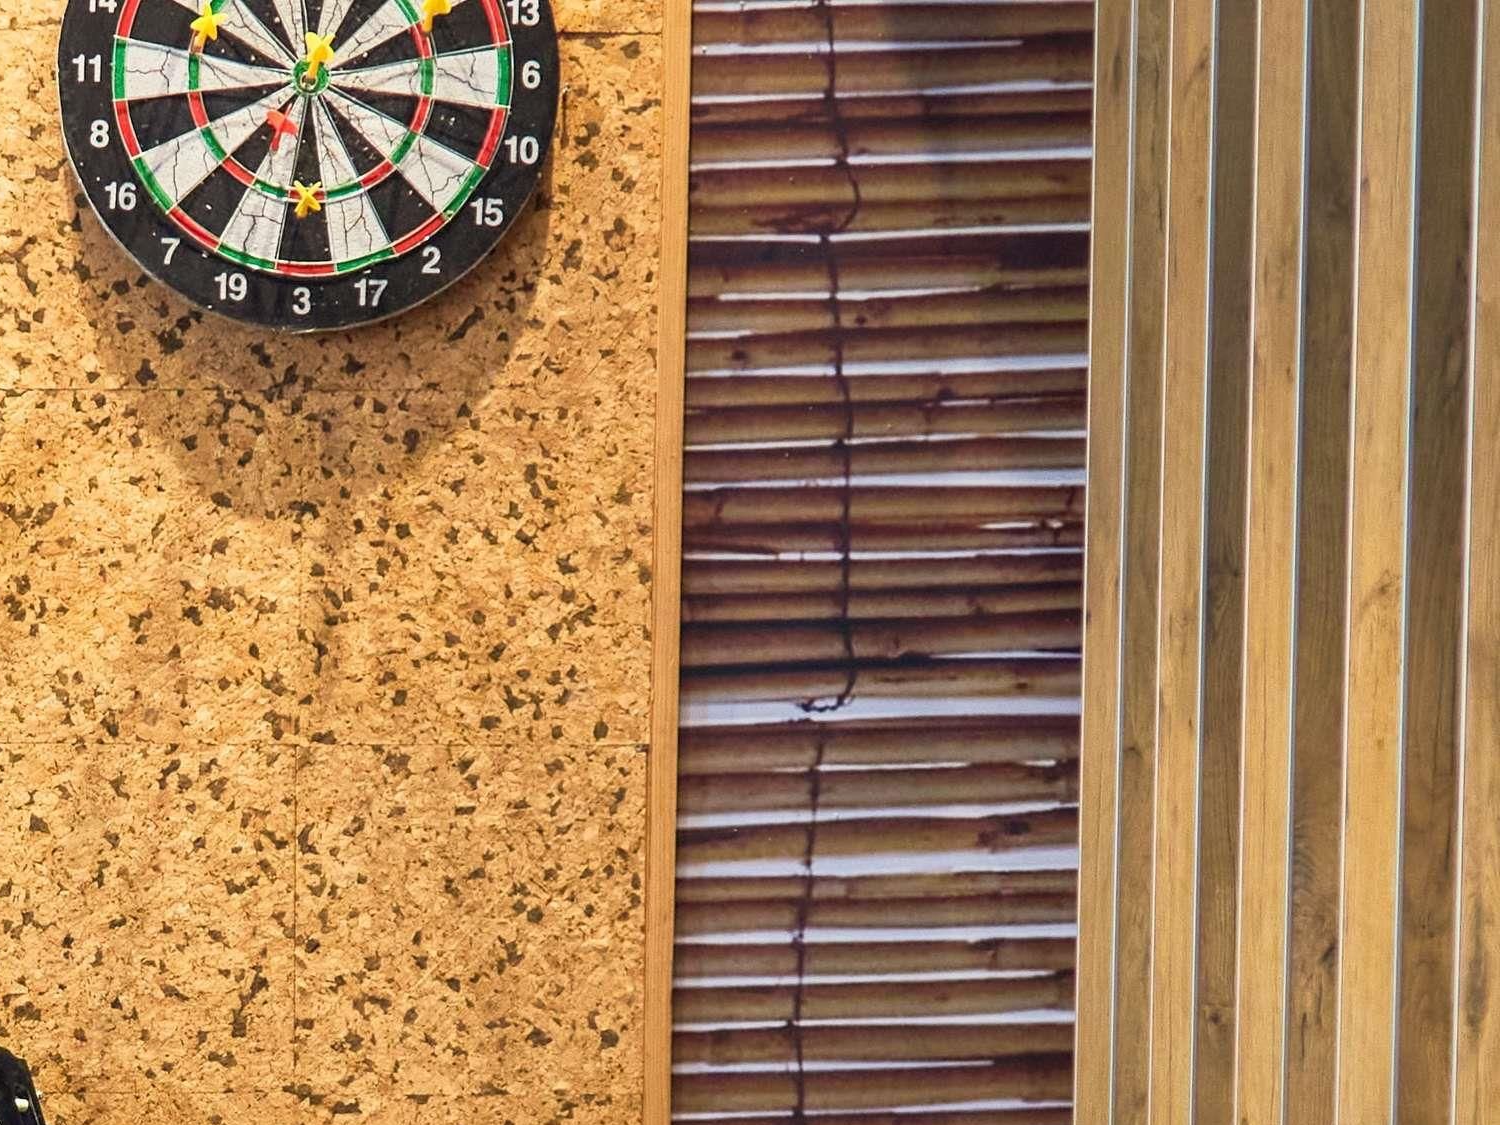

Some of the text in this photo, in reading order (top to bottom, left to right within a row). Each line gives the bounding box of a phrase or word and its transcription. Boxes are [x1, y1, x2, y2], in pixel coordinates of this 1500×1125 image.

[506, 0, 541, 27] 13
[71, 53, 102, 83] 11
[521, 60, 542, 90] 6
[89, 119, 110, 148] 8
[504, 135, 540, 165] 10
[104, 181, 137, 211] 16
[470, 197, 504, 227] 15
[160, 237, 181, 265] 7
[421, 246, 442, 275] 2
[214, 272, 248, 301] 19
[353, 278, 388, 307] 17
[292, 287, 312, 316] 3
